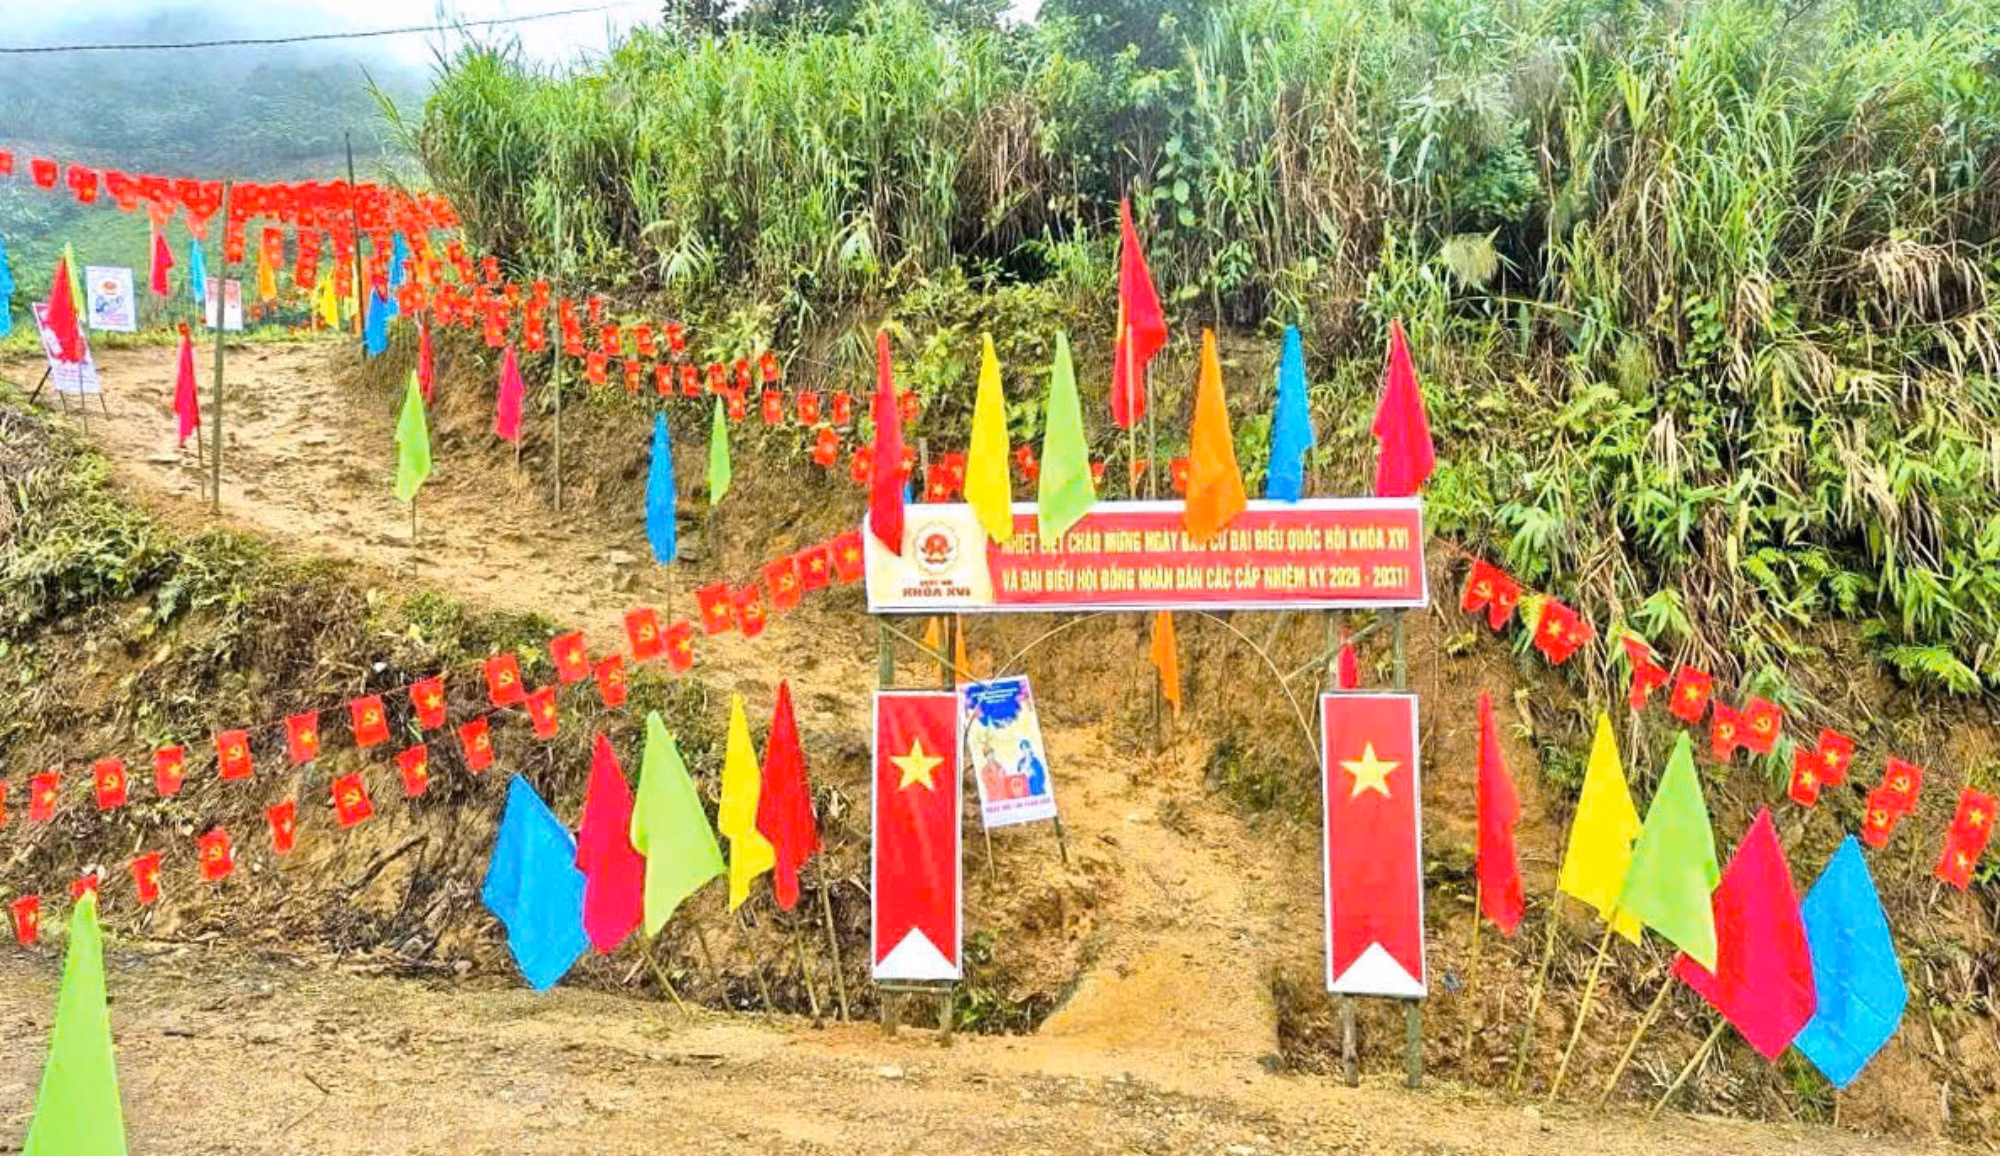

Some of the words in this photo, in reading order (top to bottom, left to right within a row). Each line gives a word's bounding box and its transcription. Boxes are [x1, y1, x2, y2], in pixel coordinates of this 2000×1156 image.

[1068, 527, 1102, 553] CHÀO
[1104, 526, 1141, 553] MỪNG
[1144, 526, 1177, 552] NGÀY
[1230, 529, 1252, 556] ĐẠI
[1255, 521, 1283, 551] BIỂU
[1287, 524, 1321, 554] QUỐC
[1325, 525, 1347, 555] HỘI
[1388, 528, 1408, 550] XVI
[946, 586, 971, 597] XVI
[1002, 566, 1019, 592] VÀ
[1021, 567, 1042, 595] ĐẠI
[1045, 561, 1074, 592] BIỂU
[1077, 565, 1098, 596] HỘI
[1101, 562, 1136, 592] ĐỒNG
[1138, 564, 1174, 591] NHÂN
[1177, 564, 1203, 590] DÂN
[1205, 564, 1232, 590] CÁC
[1235, 560, 1261, 589] CẤP
[1263, 563, 1306, 591] NHIỆM
